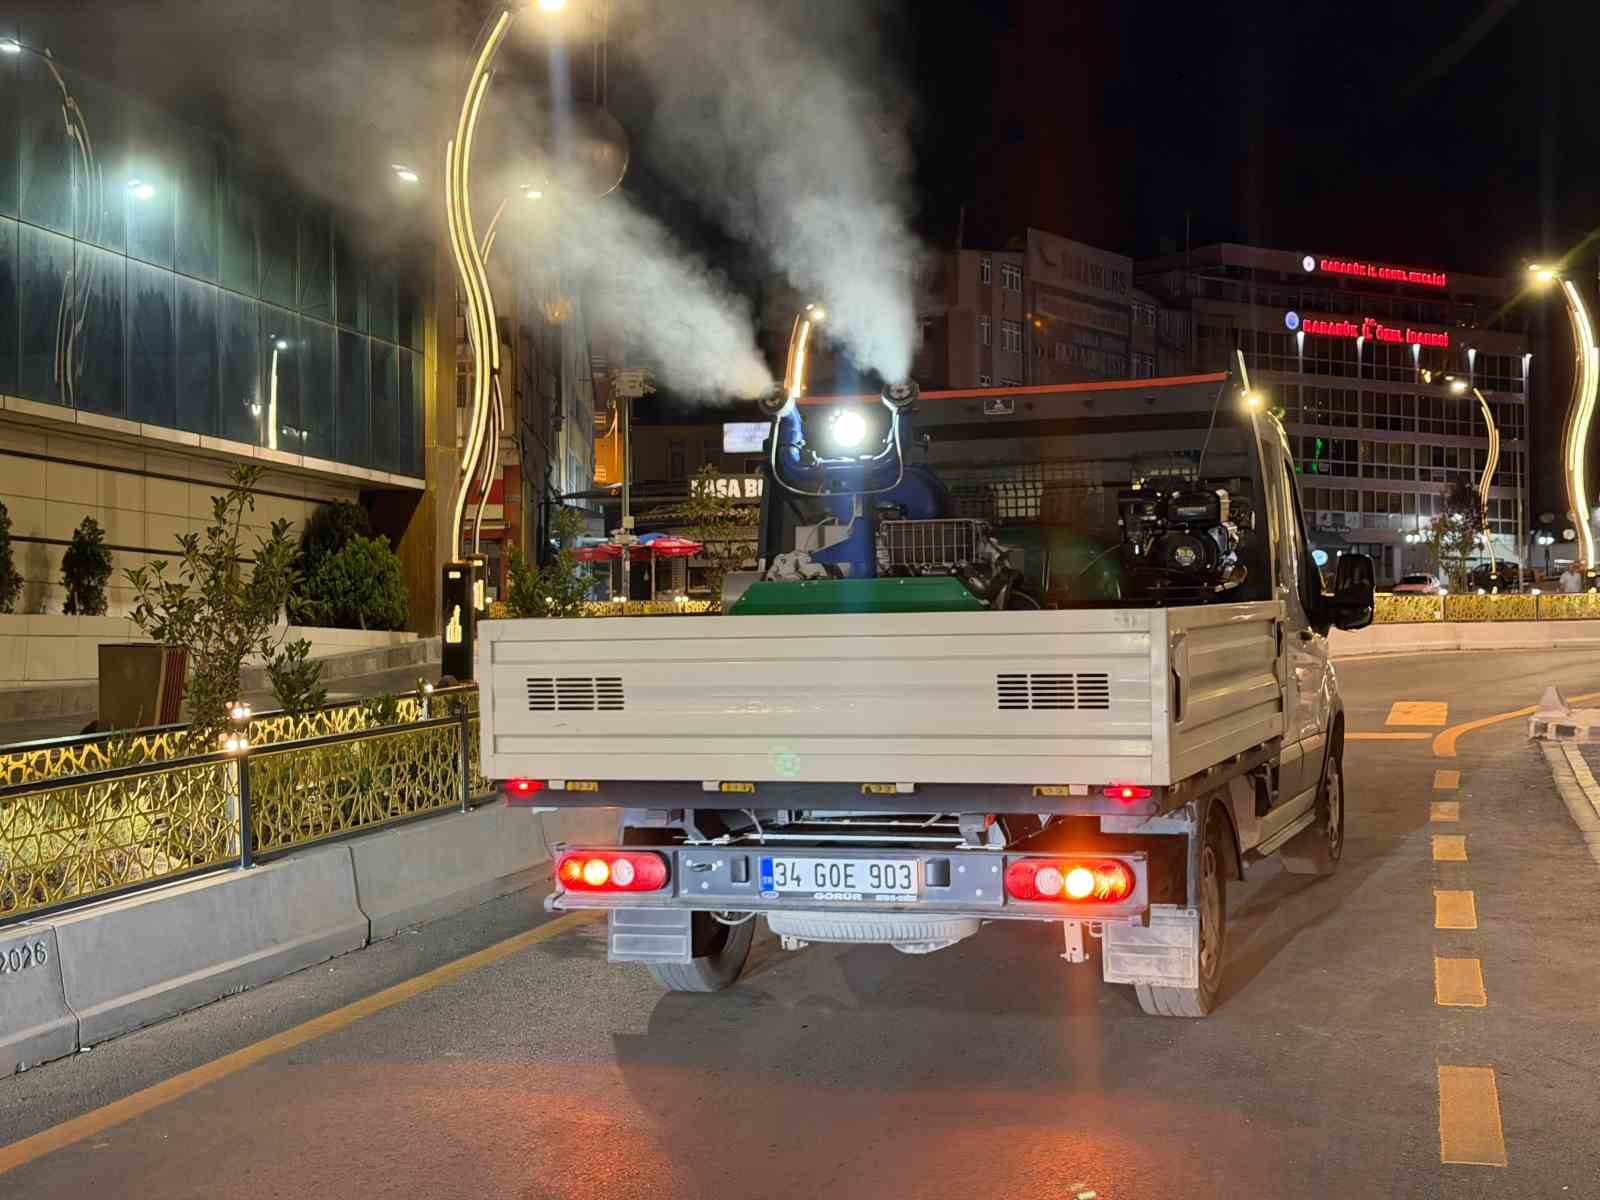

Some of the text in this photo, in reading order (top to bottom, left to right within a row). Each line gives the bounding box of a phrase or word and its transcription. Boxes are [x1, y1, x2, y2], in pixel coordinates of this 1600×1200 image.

[775, 862, 912, 890] 34 GOE 903
